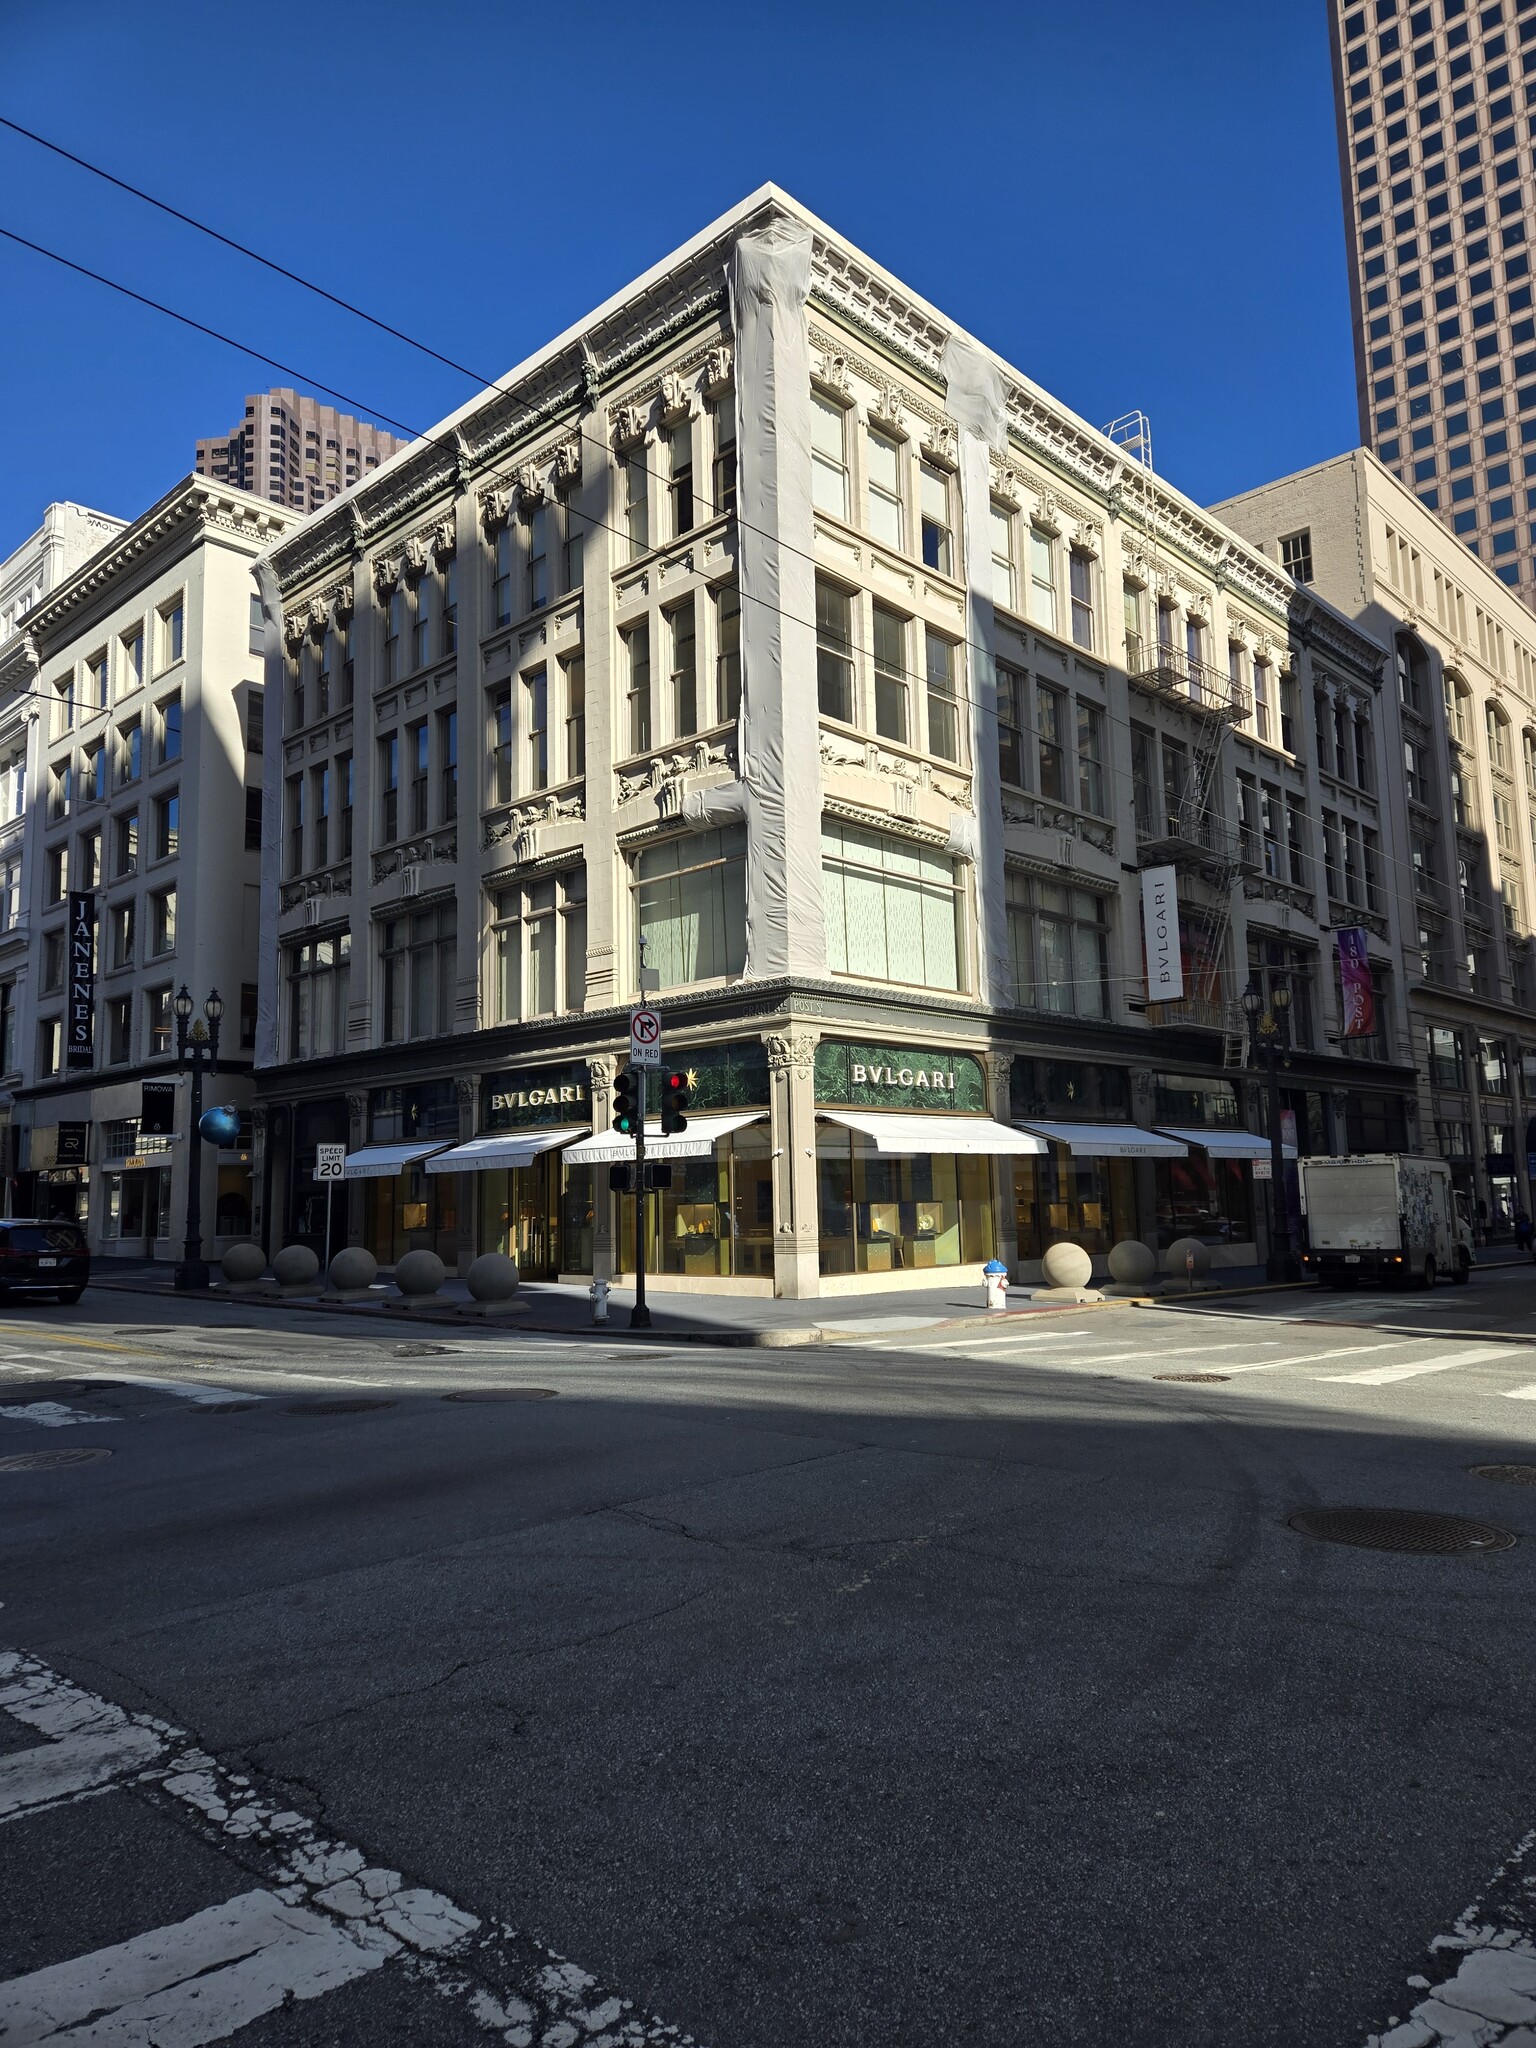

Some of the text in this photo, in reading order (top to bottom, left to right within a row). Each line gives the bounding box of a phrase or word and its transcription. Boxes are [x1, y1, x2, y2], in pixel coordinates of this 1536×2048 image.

[1155, 883, 1170, 983] BVLGARI
[74, 901, 92, 1041] JANENES
[1349, 934, 1364, 1029] 180 POST
[743, 1002, 772, 1017] GRANT
[794, 1000, 814, 1012] POST
[68, 1045, 93, 1054] BRIDAL
[633, 1048, 658, 1058] ON RED
[851, 1064, 954, 1089] BVLGARI
[144, 1085, 173, 1093] RIMOWA
[491, 1085, 586, 1110] BVLGARI
[320, 1163, 342, 1176] 20
